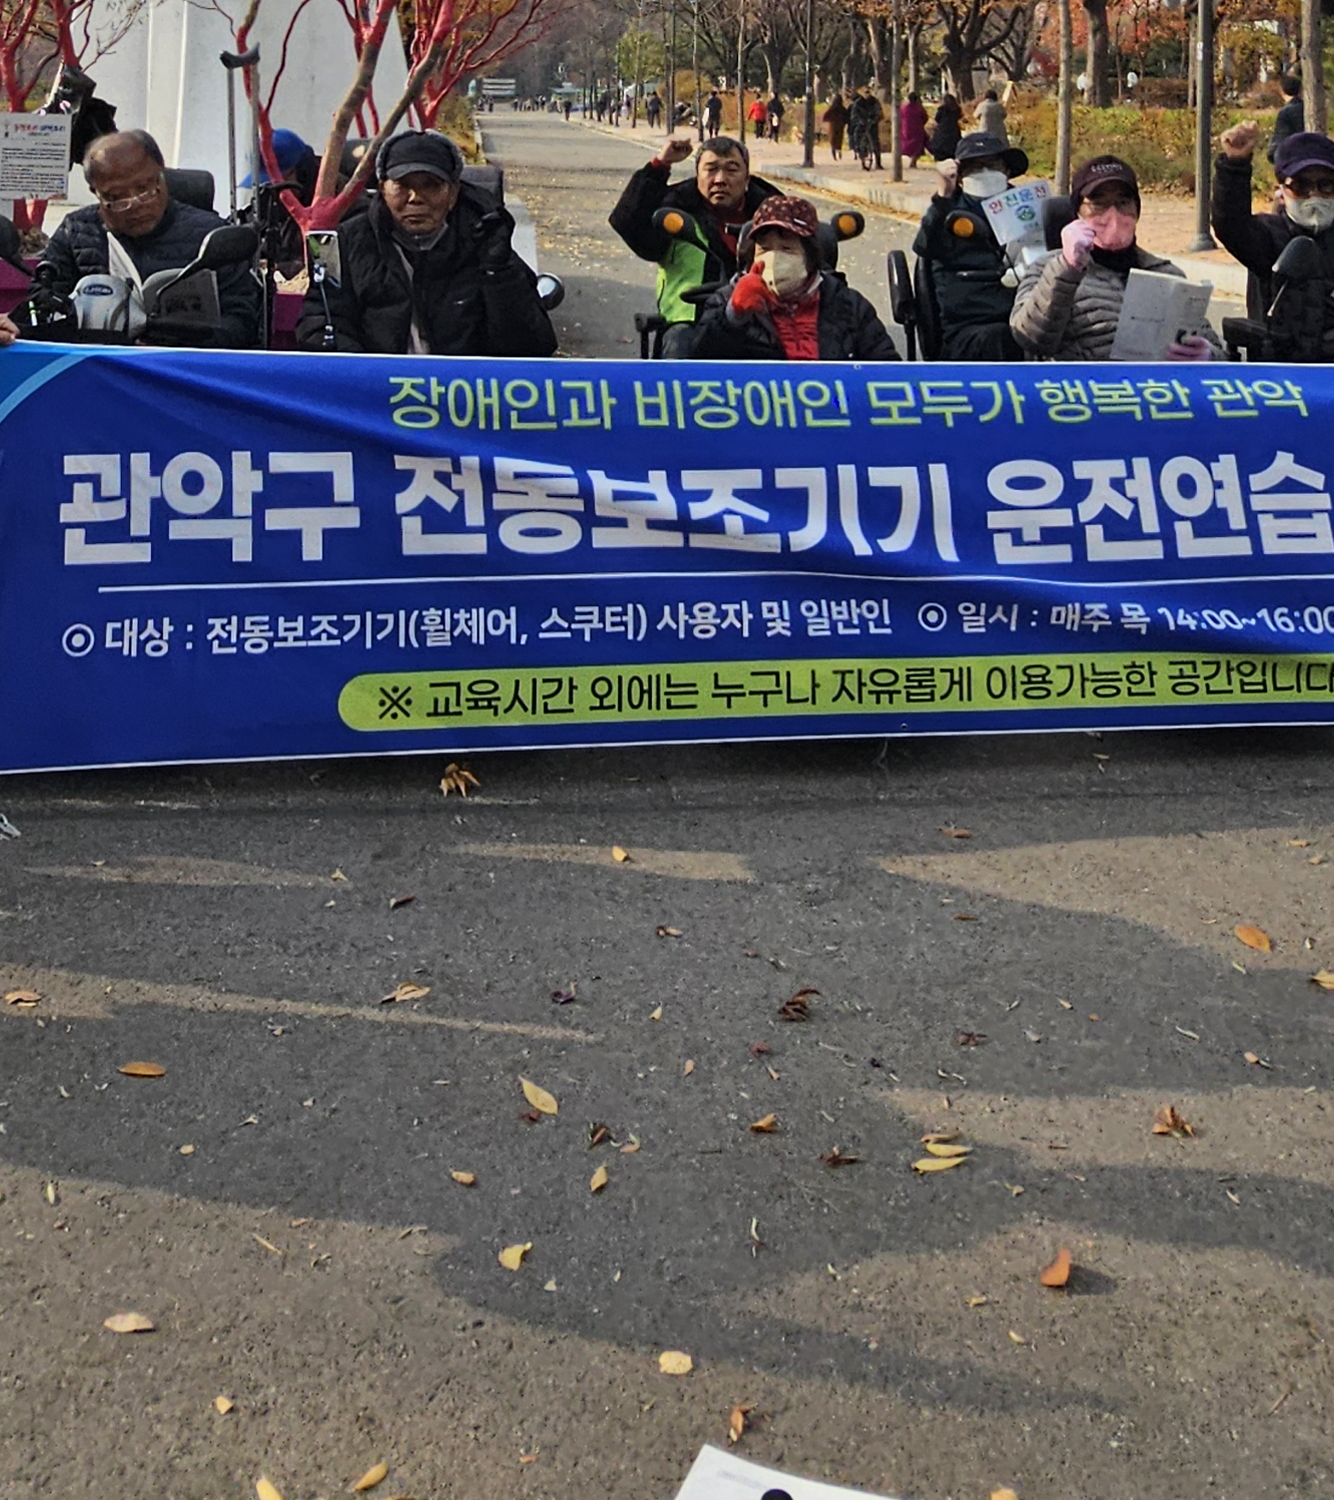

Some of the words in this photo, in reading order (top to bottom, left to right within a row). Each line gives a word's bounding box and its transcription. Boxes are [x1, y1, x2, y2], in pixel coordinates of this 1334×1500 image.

[390, 378, 616, 429] 장애인과
[635, 382, 849, 428] 비장애인
[867, 382, 1024, 427] 모두가
[1037, 381, 1193, 422] 행복한
[1205, 381, 1308, 416] 관악
[60, 452, 359, 564] 관악구
[395, 455, 959, 561] 전동보조기기
[987, 451, 1334, 564] 운전연습
[106, 618, 173, 656] 대상
[207, 607, 527, 653] 전동보조기기(휠체어,
[539, 604, 646, 641] 스쿠터)
[657, 601, 753, 638] 사용자
[762, 601, 790, 636] 및
[801, 599, 891, 635] 일반인
[959, 603, 1017, 632] 일시
[1051, 603, 1111, 631] 매주
[1121, 604, 1150, 634] 목
[426, 676, 578, 717] 교육시간
[589, 673, 699, 713] 외에는
[711, 669, 821, 709] 누구나
[829, 664, 975, 705] 자유롭게
[983, 659, 1159, 703] 이용가능한
